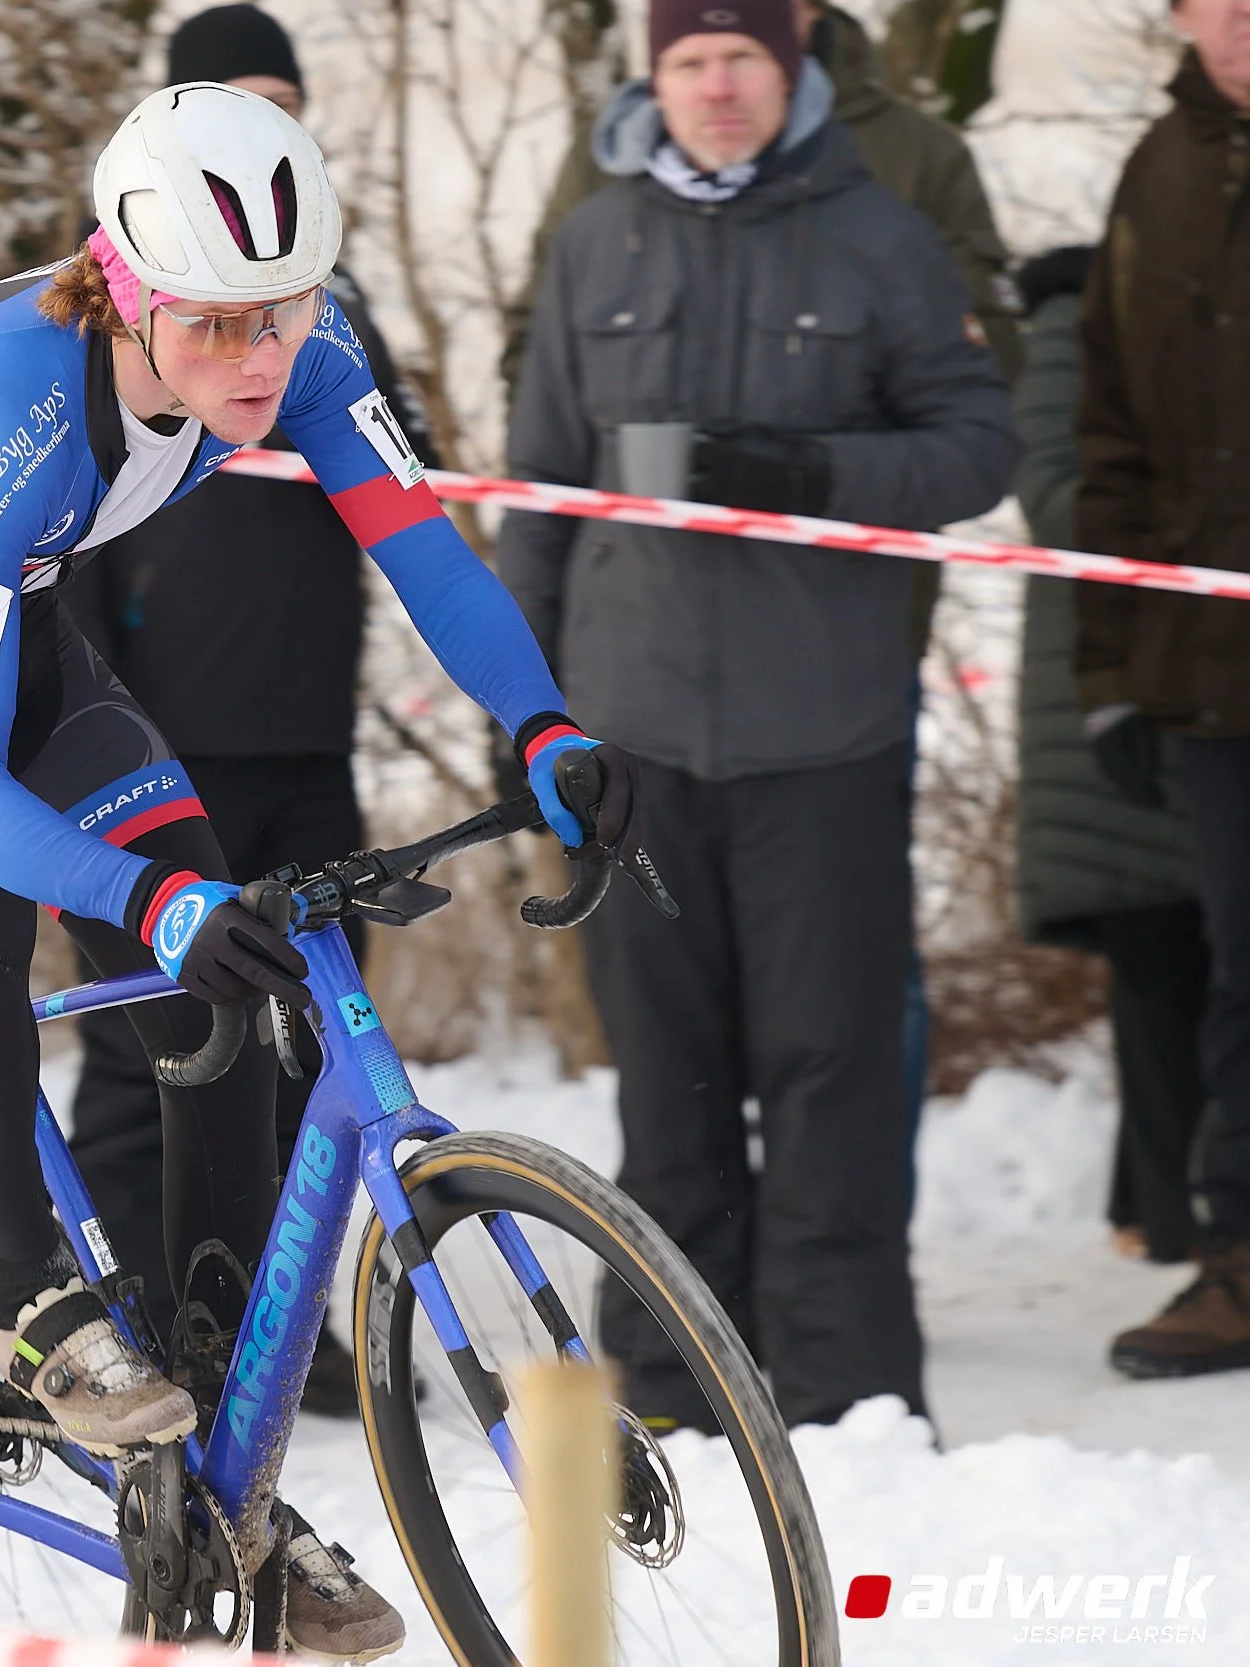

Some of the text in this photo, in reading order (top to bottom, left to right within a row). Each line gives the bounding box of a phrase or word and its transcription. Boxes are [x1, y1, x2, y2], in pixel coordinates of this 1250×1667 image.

[30, 381, 66, 433] Aps
[11, 475, 26, 492] og
[22, 420, 70, 478] snedkerfirma
[79, 780, 158, 831] CRAFT
[226, 1123, 338, 1458] ARGON 18
